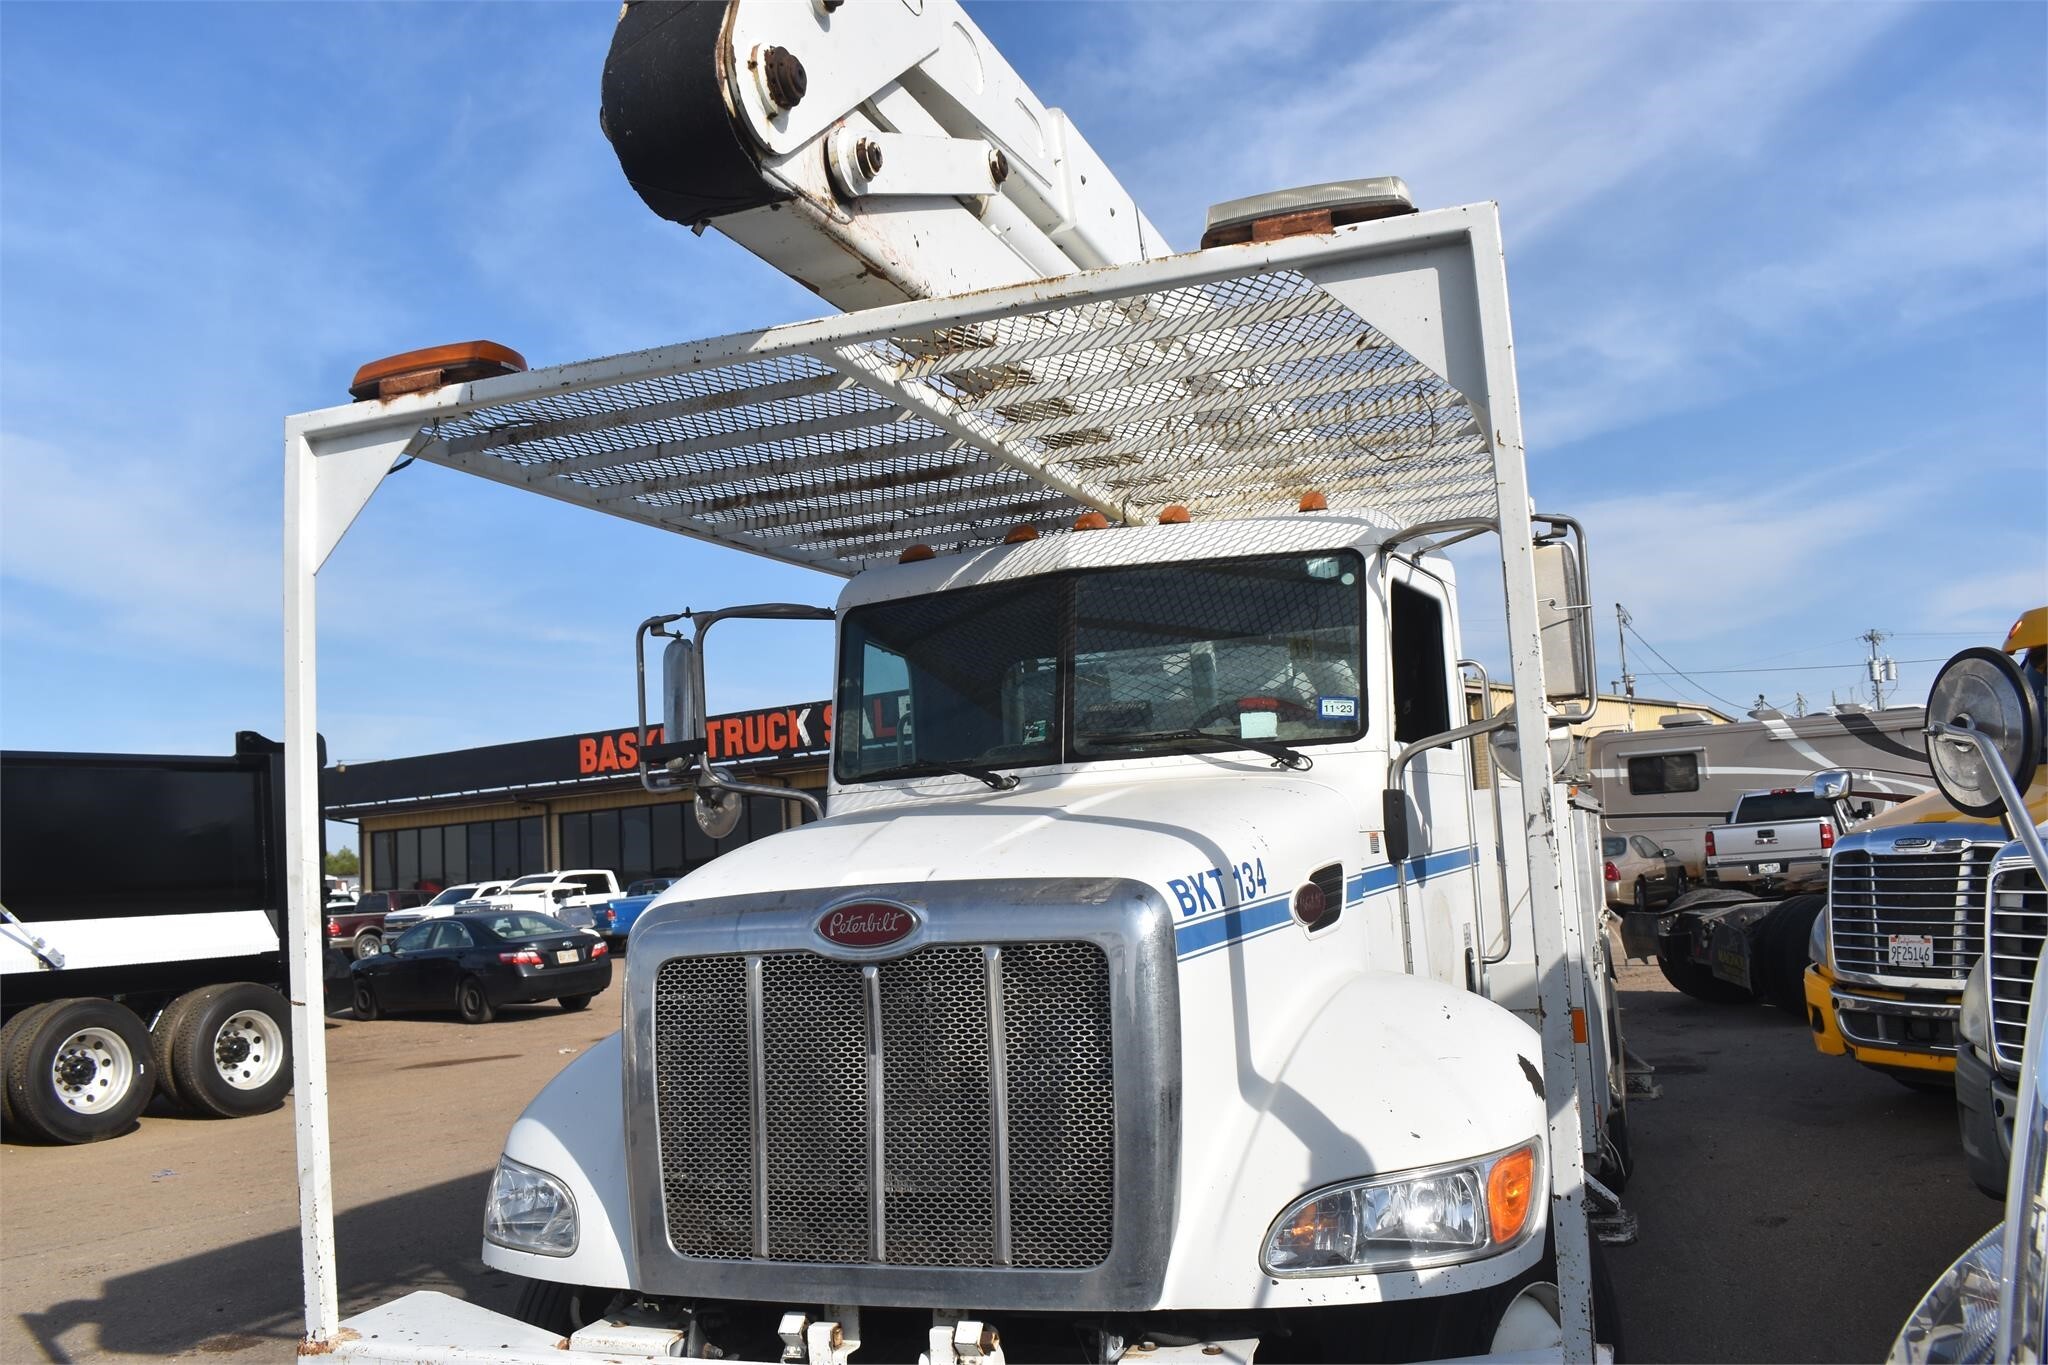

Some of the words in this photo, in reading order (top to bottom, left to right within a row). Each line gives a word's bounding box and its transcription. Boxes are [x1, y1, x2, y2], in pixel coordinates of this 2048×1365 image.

[706, 708, 812, 758] TRUCK
[1167, 868, 1226, 917] BKT
[1233, 857, 1267, 901] 134
[829, 912, 905, 937] Peterbilt
[1891, 945, 1930, 962] 9F25146
